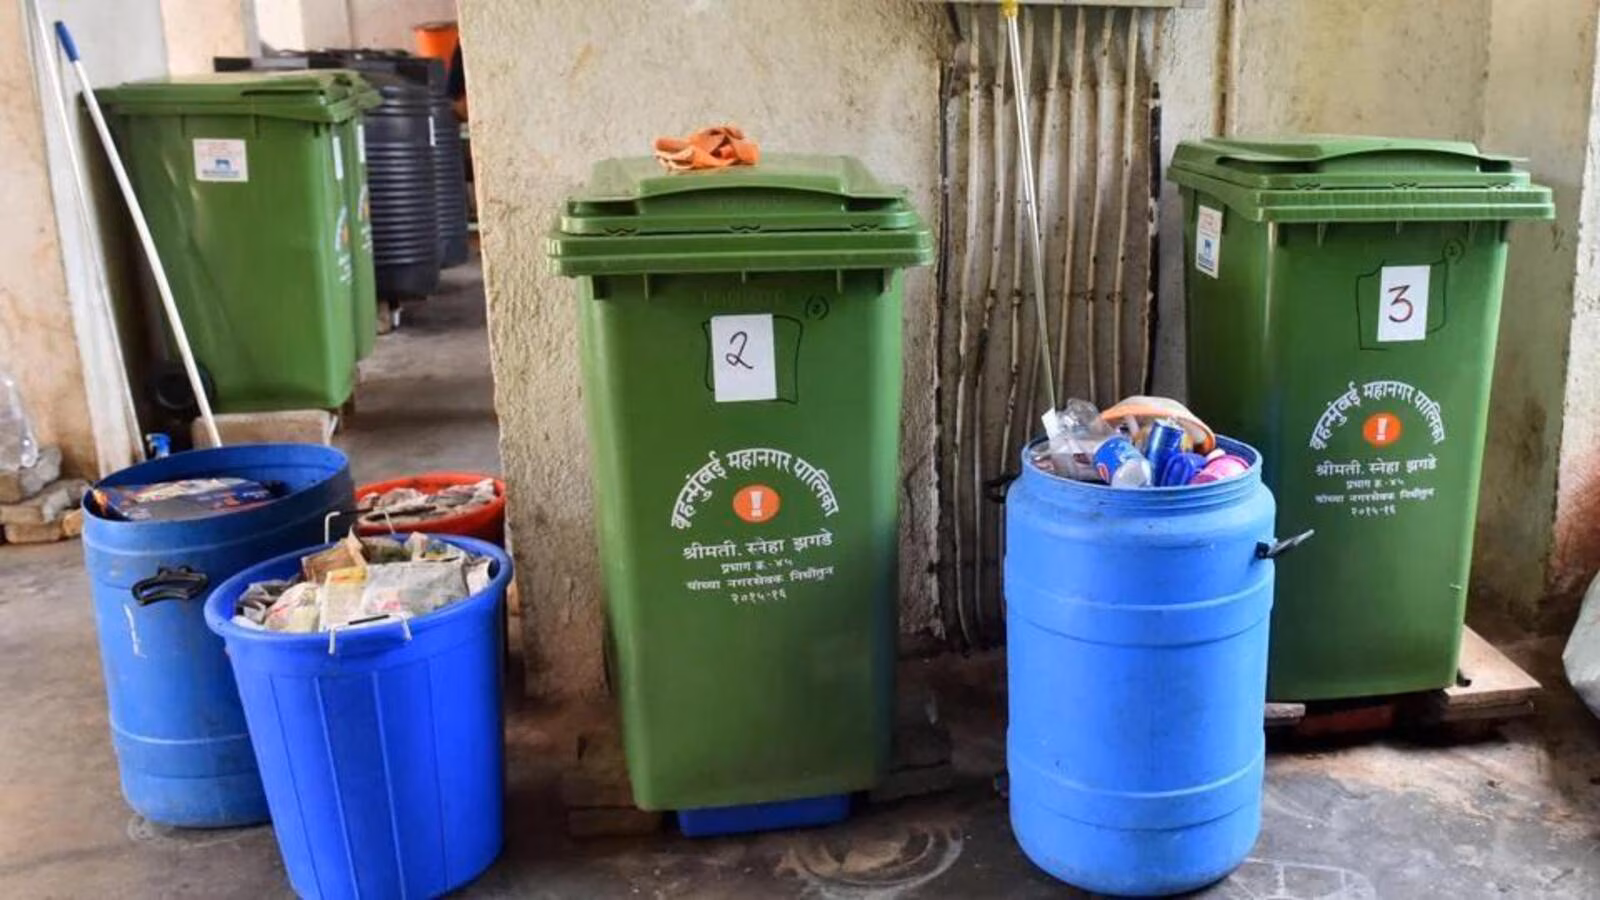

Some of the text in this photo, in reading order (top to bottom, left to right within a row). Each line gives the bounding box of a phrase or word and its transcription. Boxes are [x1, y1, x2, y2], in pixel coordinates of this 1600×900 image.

[1387, 285, 1413, 323] 3
[726, 331, 754, 370] 2
[1362, 380, 1415, 404] महानगर
[1414, 390, 1445, 445] पालिका
[726, 448, 792, 472] महानगर
[794, 457, 839, 518] पालिका
